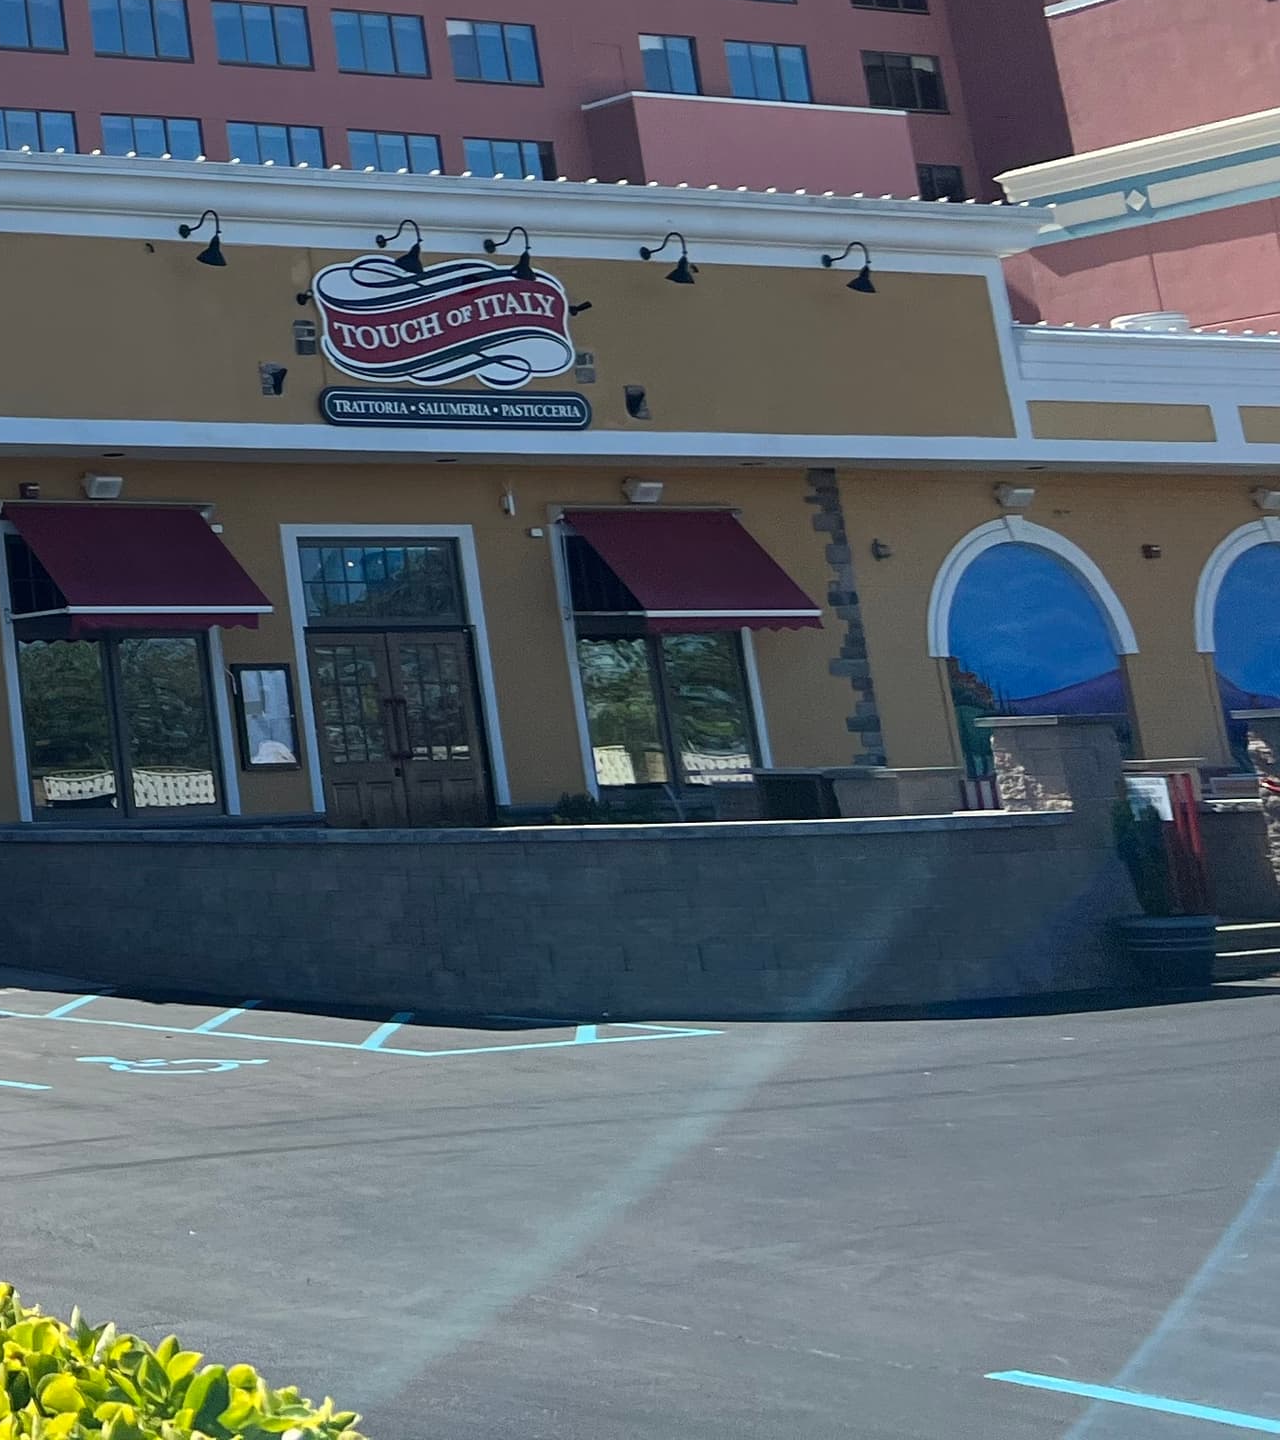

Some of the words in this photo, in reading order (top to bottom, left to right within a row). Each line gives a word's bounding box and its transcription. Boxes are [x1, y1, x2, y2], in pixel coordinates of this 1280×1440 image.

[333, 312, 444, 350] TOUCH
[473, 291, 556, 323] ITALY
[333, 399, 408, 415] TRATTORIA
[418, 401, 491, 417] SALUMERIA
[501, 403, 582, 419] PASTICCERIA
